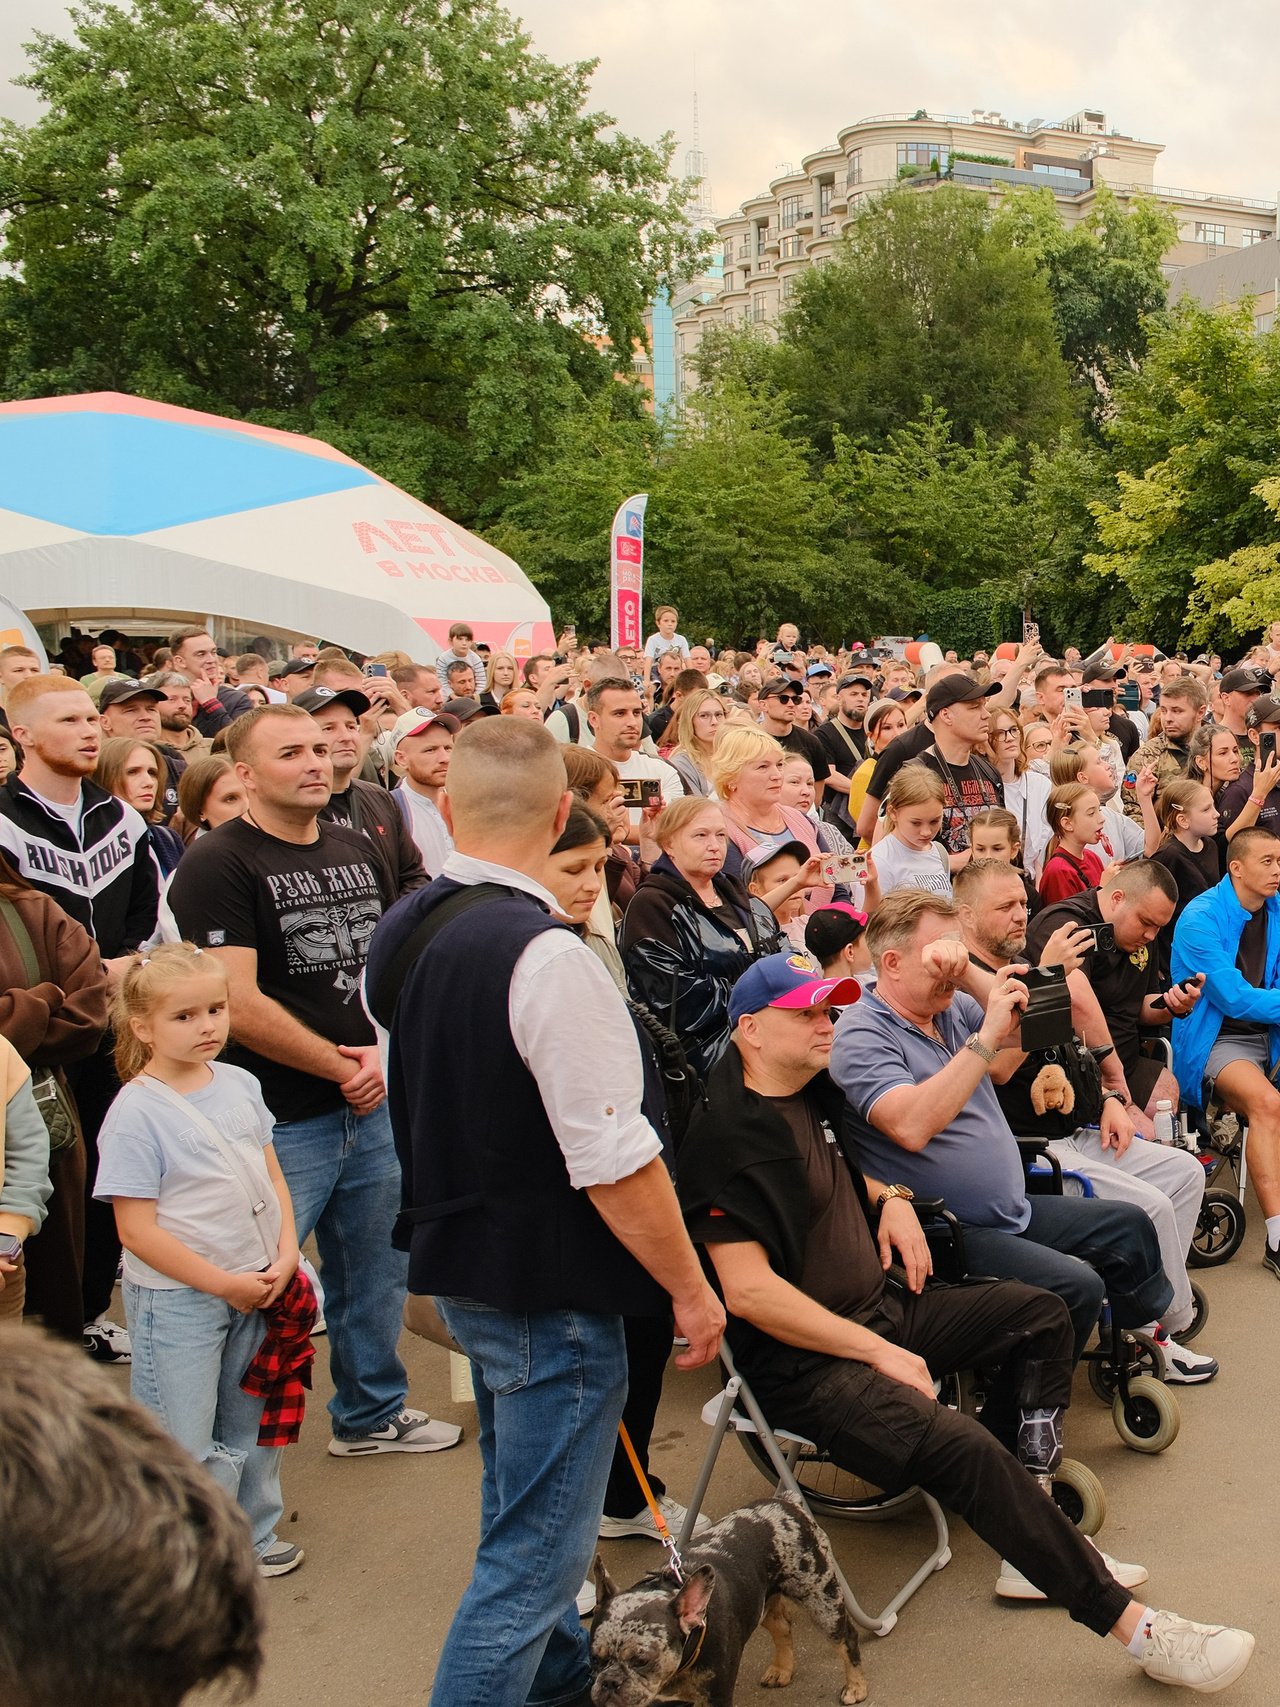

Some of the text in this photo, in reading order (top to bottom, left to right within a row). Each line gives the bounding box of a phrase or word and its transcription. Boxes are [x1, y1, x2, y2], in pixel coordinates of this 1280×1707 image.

[376, 560, 404, 578] В
[266, 862, 377, 901] РУСЬ ЖИВА
[177, 1102, 261, 1155] TINK
